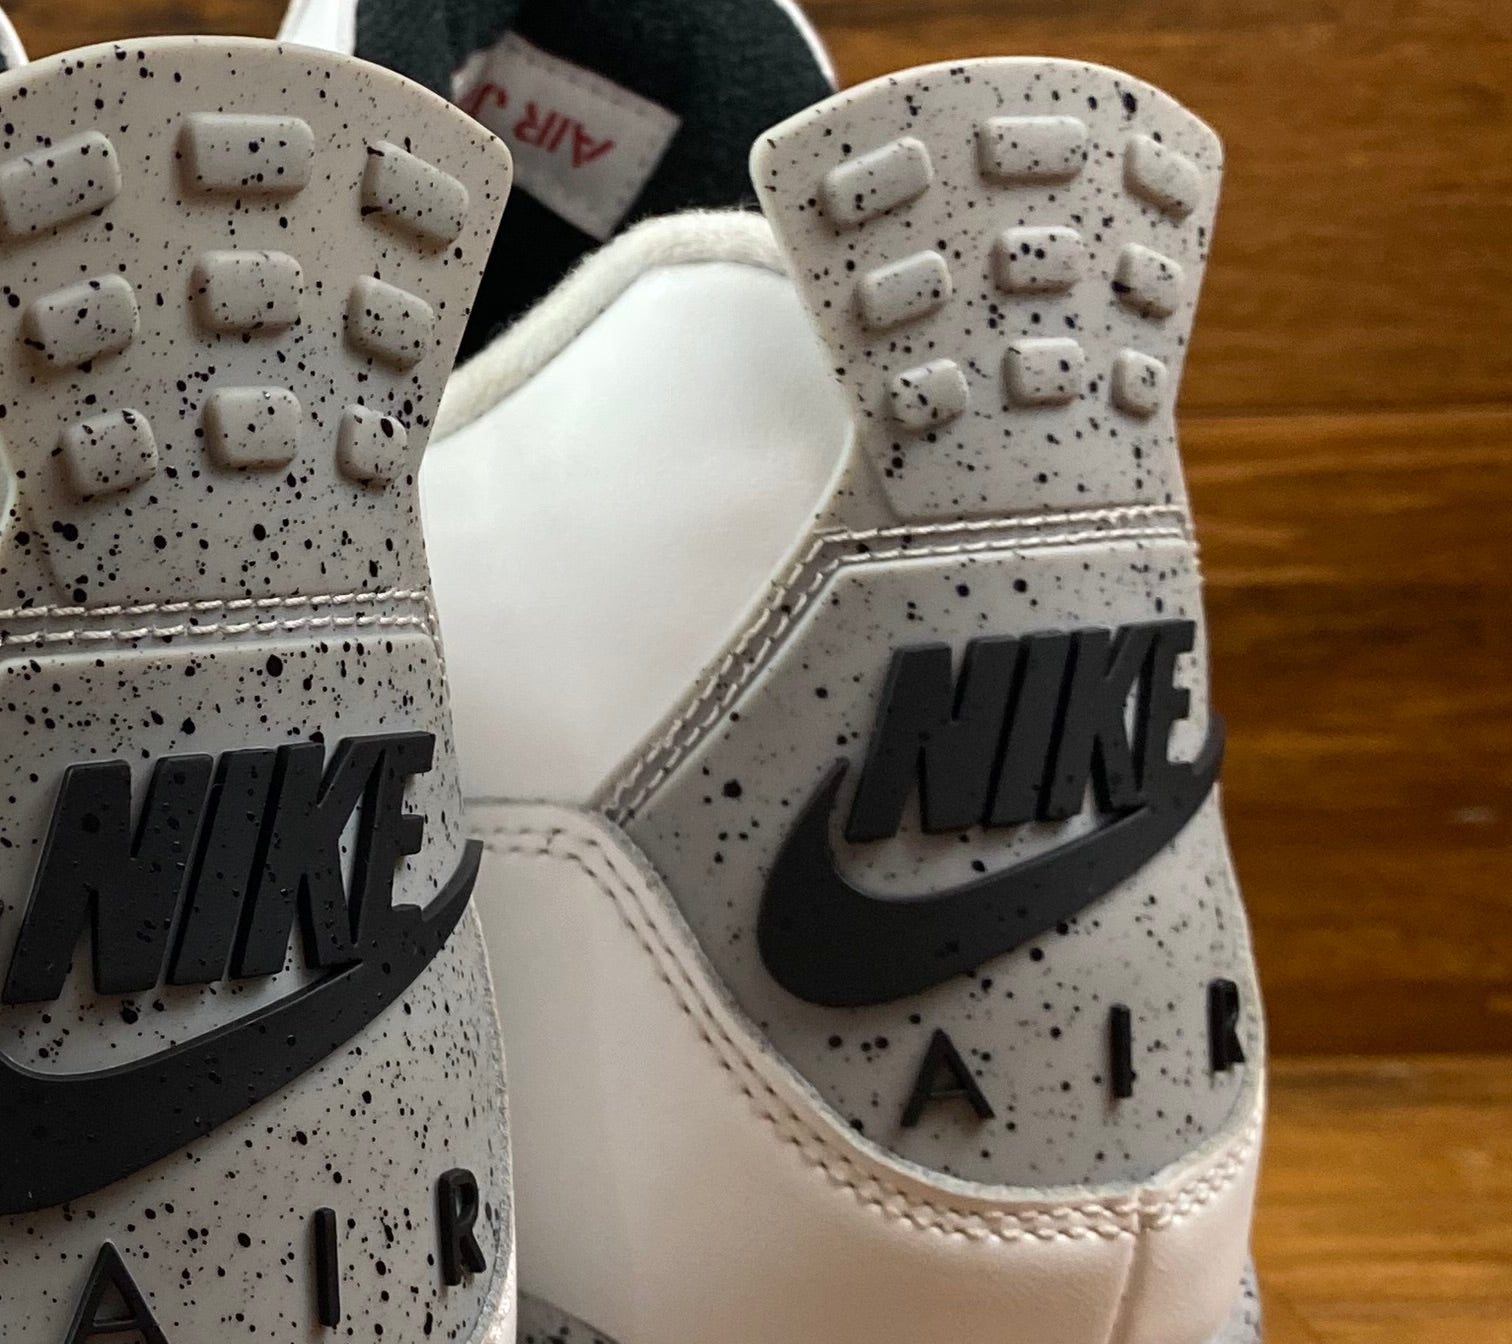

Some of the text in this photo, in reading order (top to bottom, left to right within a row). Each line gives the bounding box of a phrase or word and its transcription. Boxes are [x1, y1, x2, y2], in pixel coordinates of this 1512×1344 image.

[512, 100, 616, 169] AIR
[844, 618, 1197, 844] NIKE
[2, 729, 437, 1005] NIKE
[900, 977, 1246, 1129] AIR
